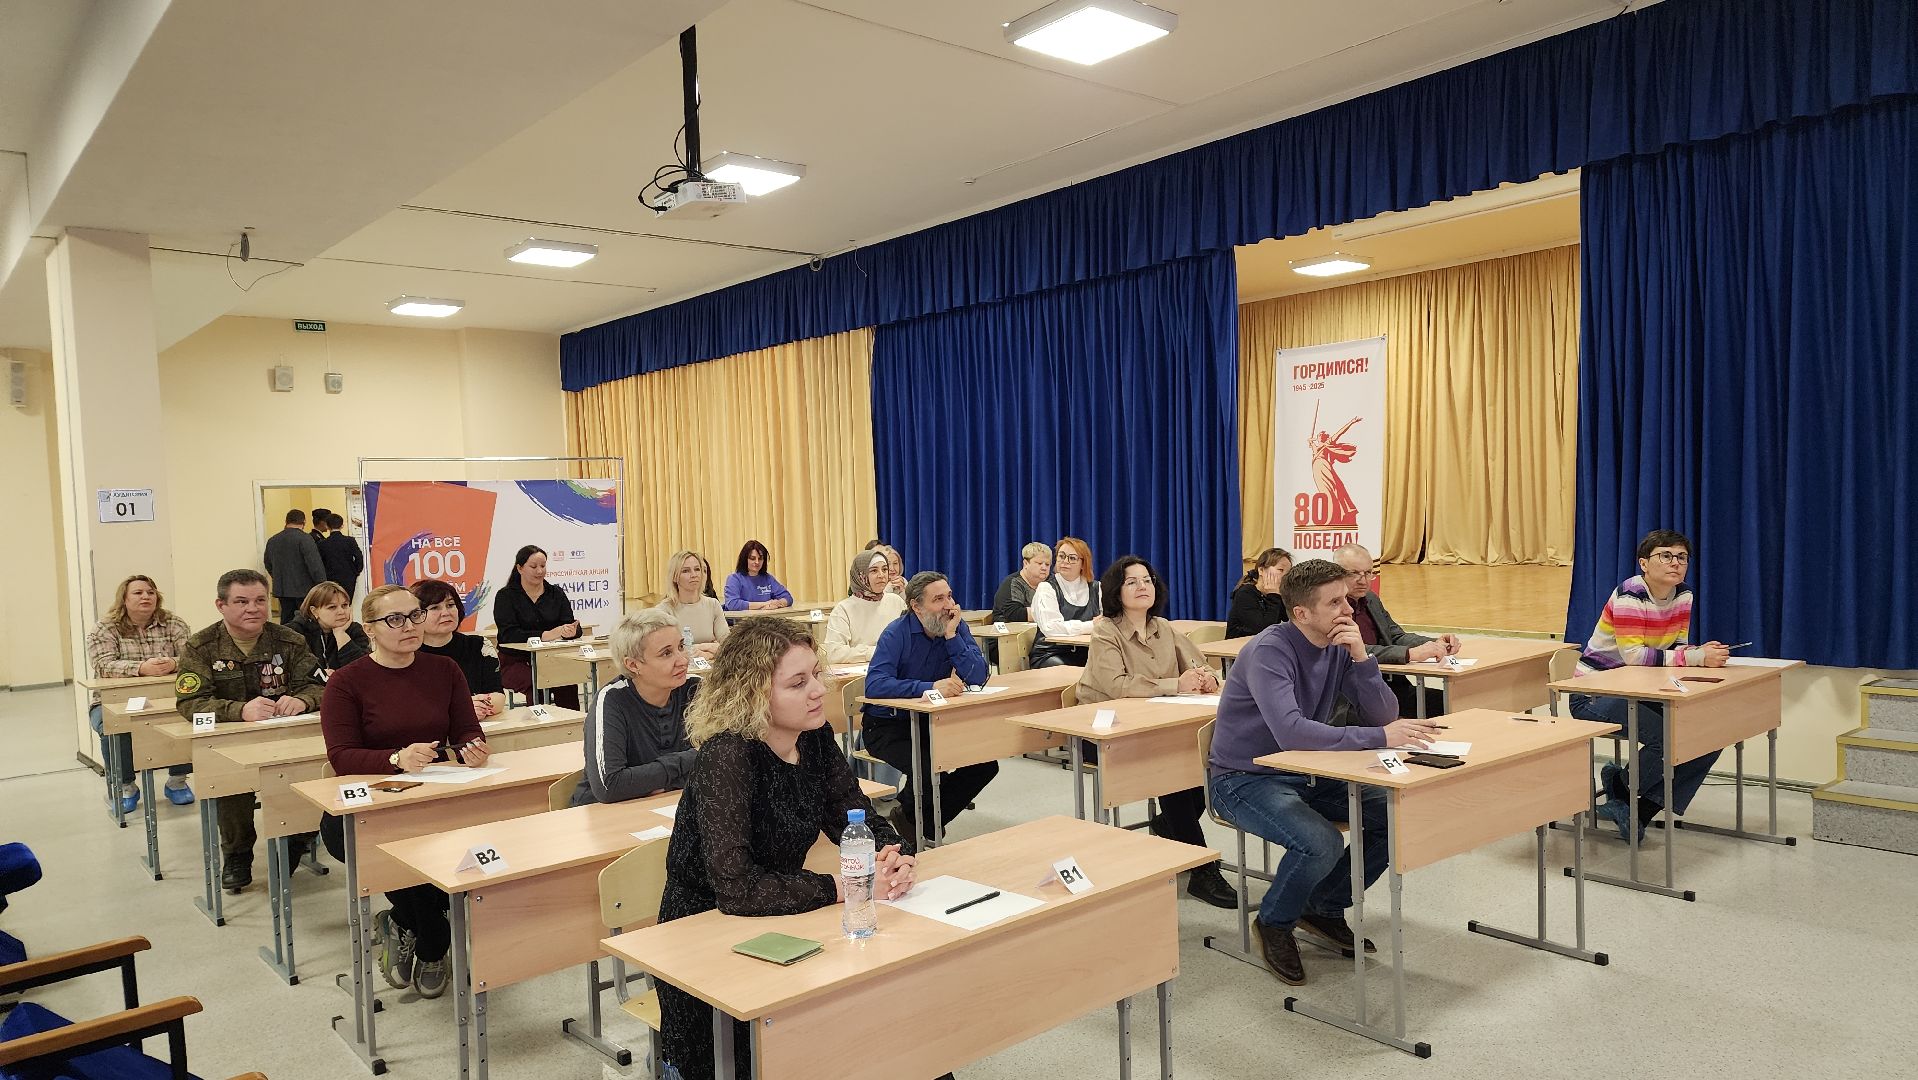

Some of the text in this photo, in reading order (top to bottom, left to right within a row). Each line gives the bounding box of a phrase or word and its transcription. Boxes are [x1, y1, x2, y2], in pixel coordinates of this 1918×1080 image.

[297, 323, 324, 331] ВЫХОД
[1293, 358, 1369, 380] ГОРДИМСЯ!
[116, 502, 136, 516] 01
[1294, 492, 1329, 527] 80
[411, 535, 461, 549] НА ВСЕ
[408, 549, 466, 580] 100
[546, 569, 588, 578] ЕРОССИЙСКАЯ
[560, 579, 609, 593] АЧИ ЕГЭ
[343, 787, 368, 800] В3
[475, 848, 501, 866] В2
[1060, 865, 1083, 884] В1
